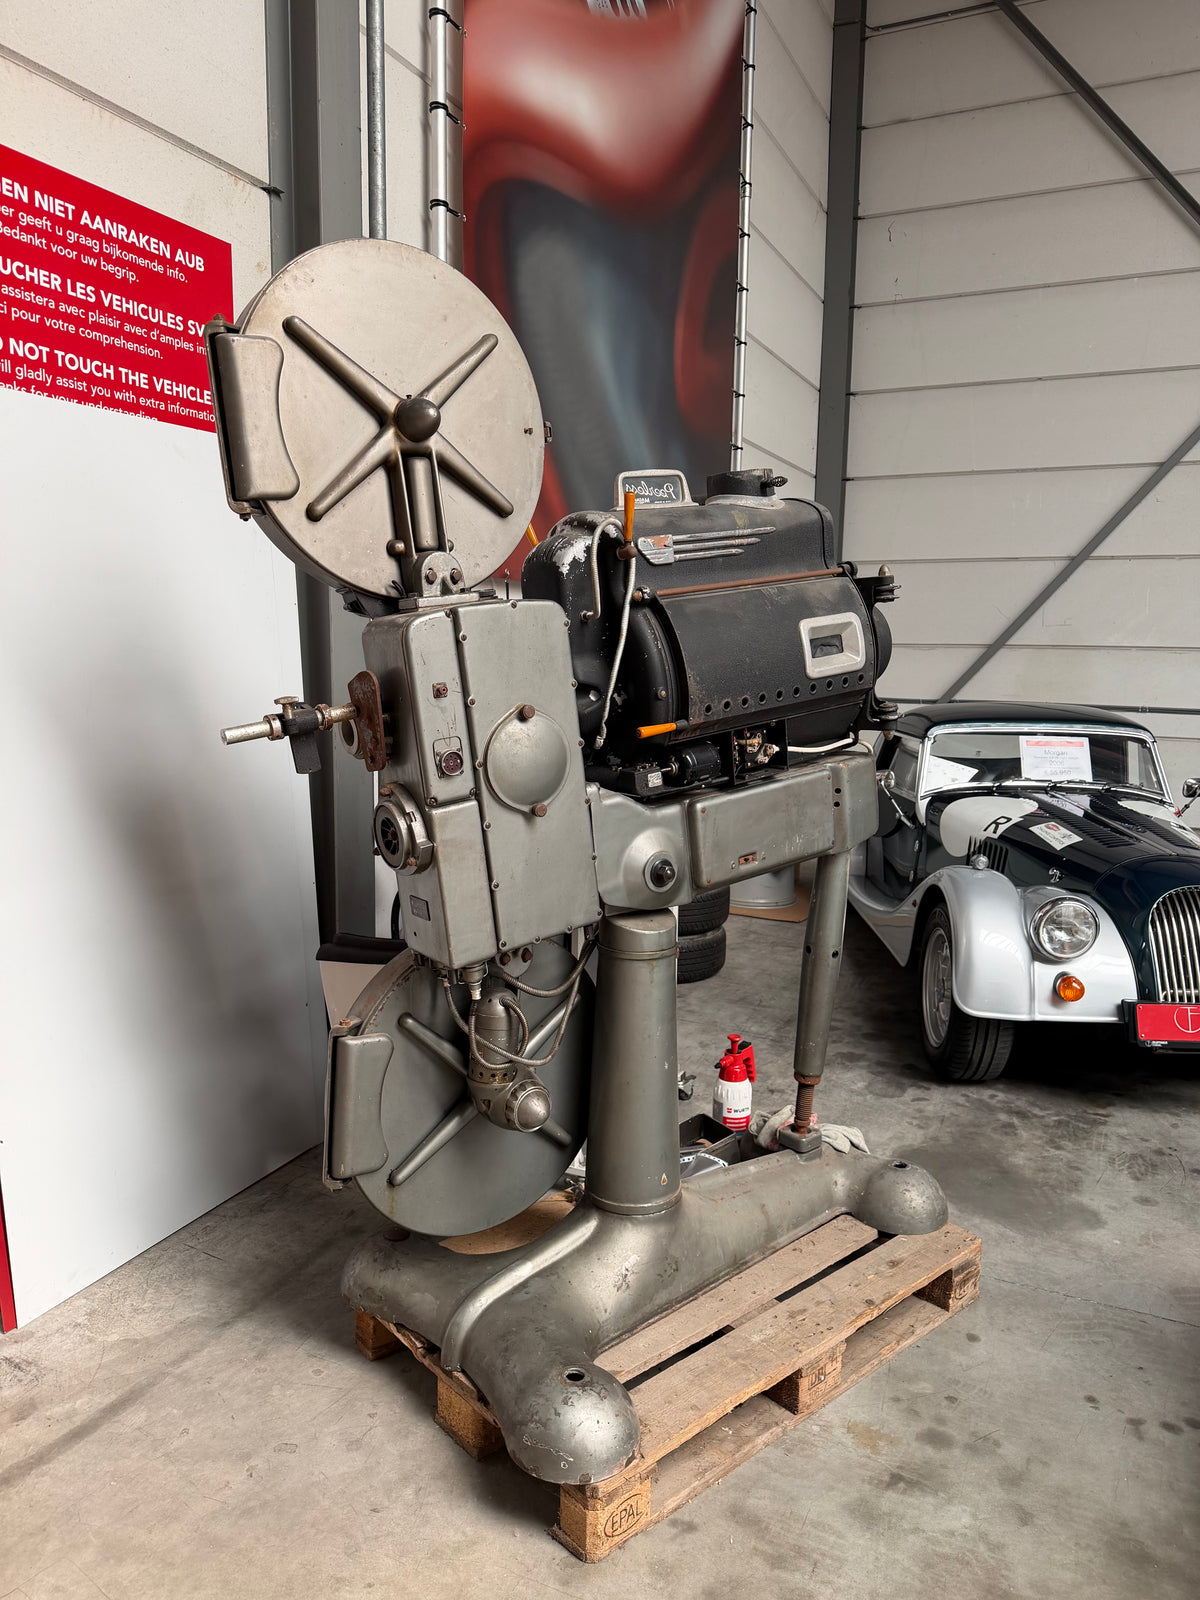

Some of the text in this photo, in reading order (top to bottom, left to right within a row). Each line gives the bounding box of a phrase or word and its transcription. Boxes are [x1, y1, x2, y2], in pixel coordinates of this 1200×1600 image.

[0, 177, 205, 272] EN NIET AANRAKEN AUB
[0, 205, 188, 283] er geeft u graag bijkomende info.
[0, 256, 62, 292] UCHER
[67, 278, 96, 303] LES
[100, 289, 184, 331] VEHICULES
[50, 242, 77, 259] voor
[81, 254, 97, 267] uw
[100, 256, 139, 284] begrip.
[1, 284, 55, 309] assistera
[58, 302, 85, 318] avec
[88, 309, 120, 329] plaisir
[123, 322, 147, 337] avec
[150, 328, 194, 352] d'amples
[11, 307, 41, 324] pour
[44, 316, 76, 334] votre
[79, 327, 163, 359] comprehension.
[0, 359, 216, 422] ill gladly assist you with extra informatio
[9, 337, 50, 363] NOT
[54, 349, 115, 380] TOUCH
[118, 366, 149, 390] THE
[153, 376, 214, 405] VEHICLE
[611, 1500, 643, 1535] EPAL
